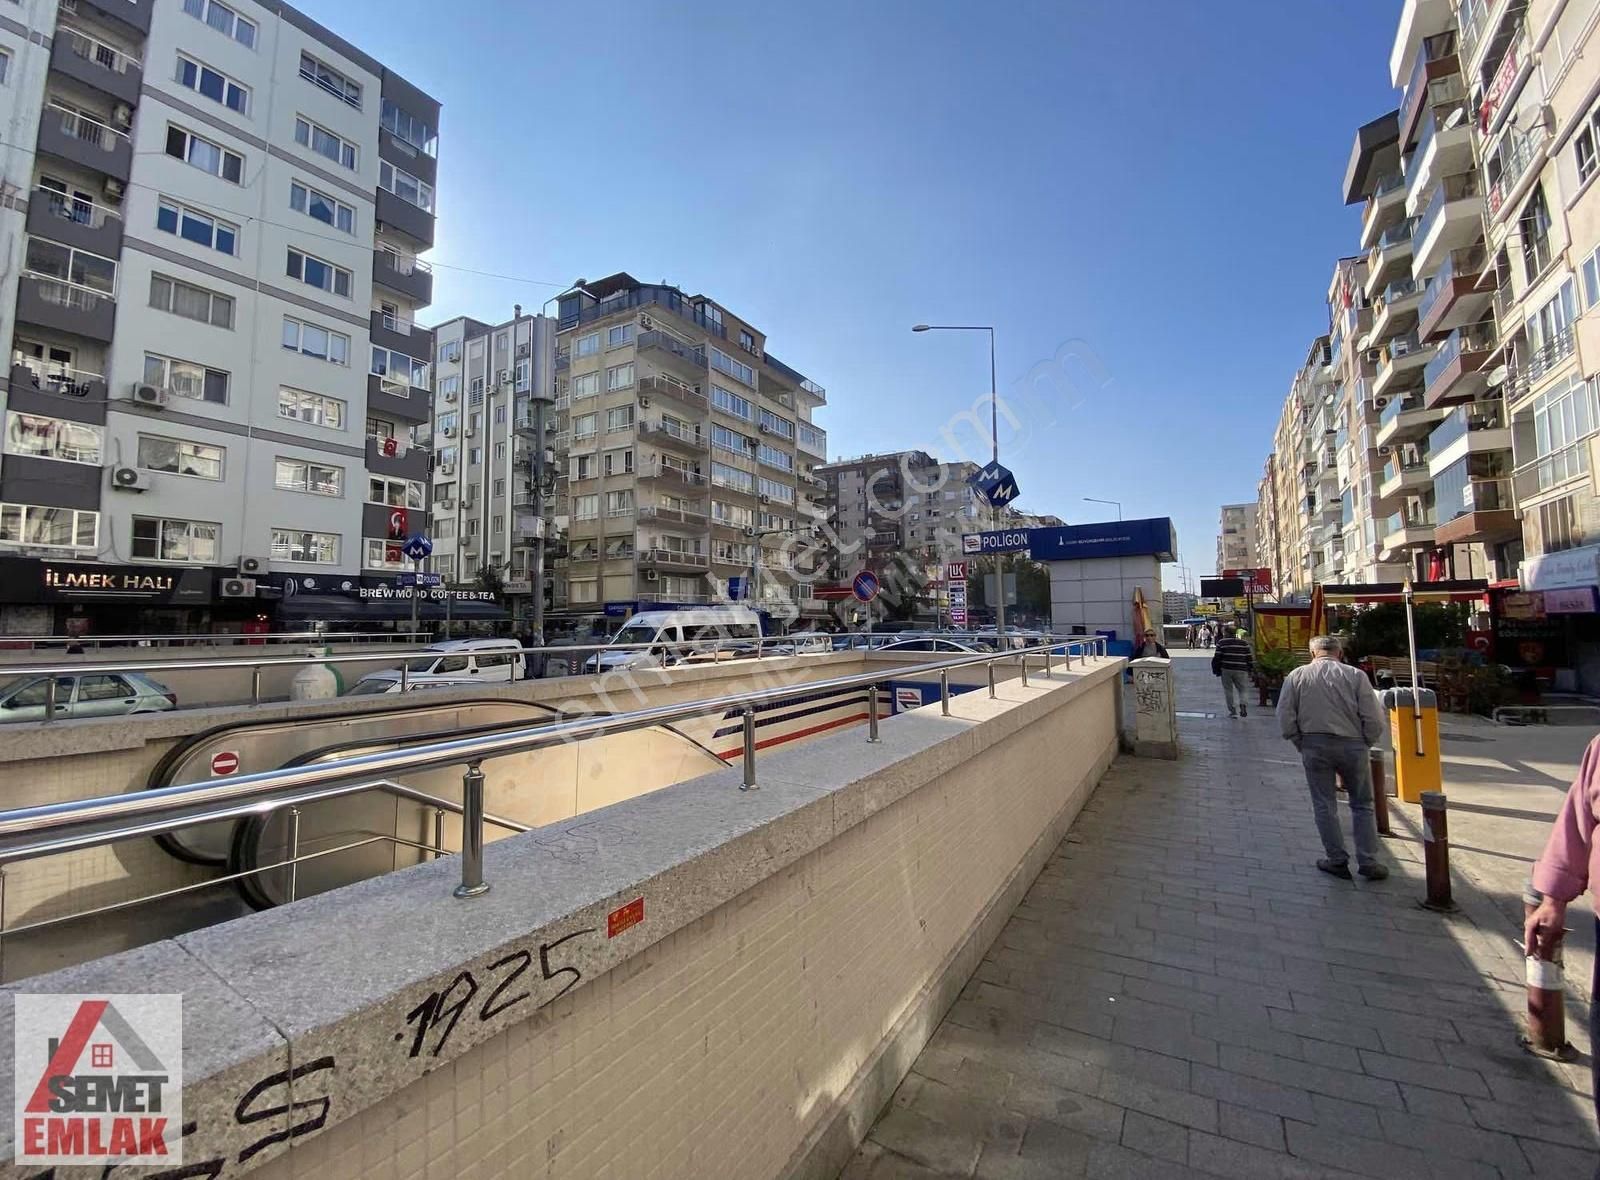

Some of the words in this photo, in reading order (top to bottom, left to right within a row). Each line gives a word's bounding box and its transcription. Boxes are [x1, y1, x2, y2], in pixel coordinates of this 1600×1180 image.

[993, 484, 1013, 500] M
[983, 532, 1028, 548] POLİGON
[409, 546, 425, 556] M
[46, 569, 115, 588] İLMEK
[123, 576, 172, 590] HALI
[360, 588, 393, 598] BREW
[478, 591, 495, 600] TEA
